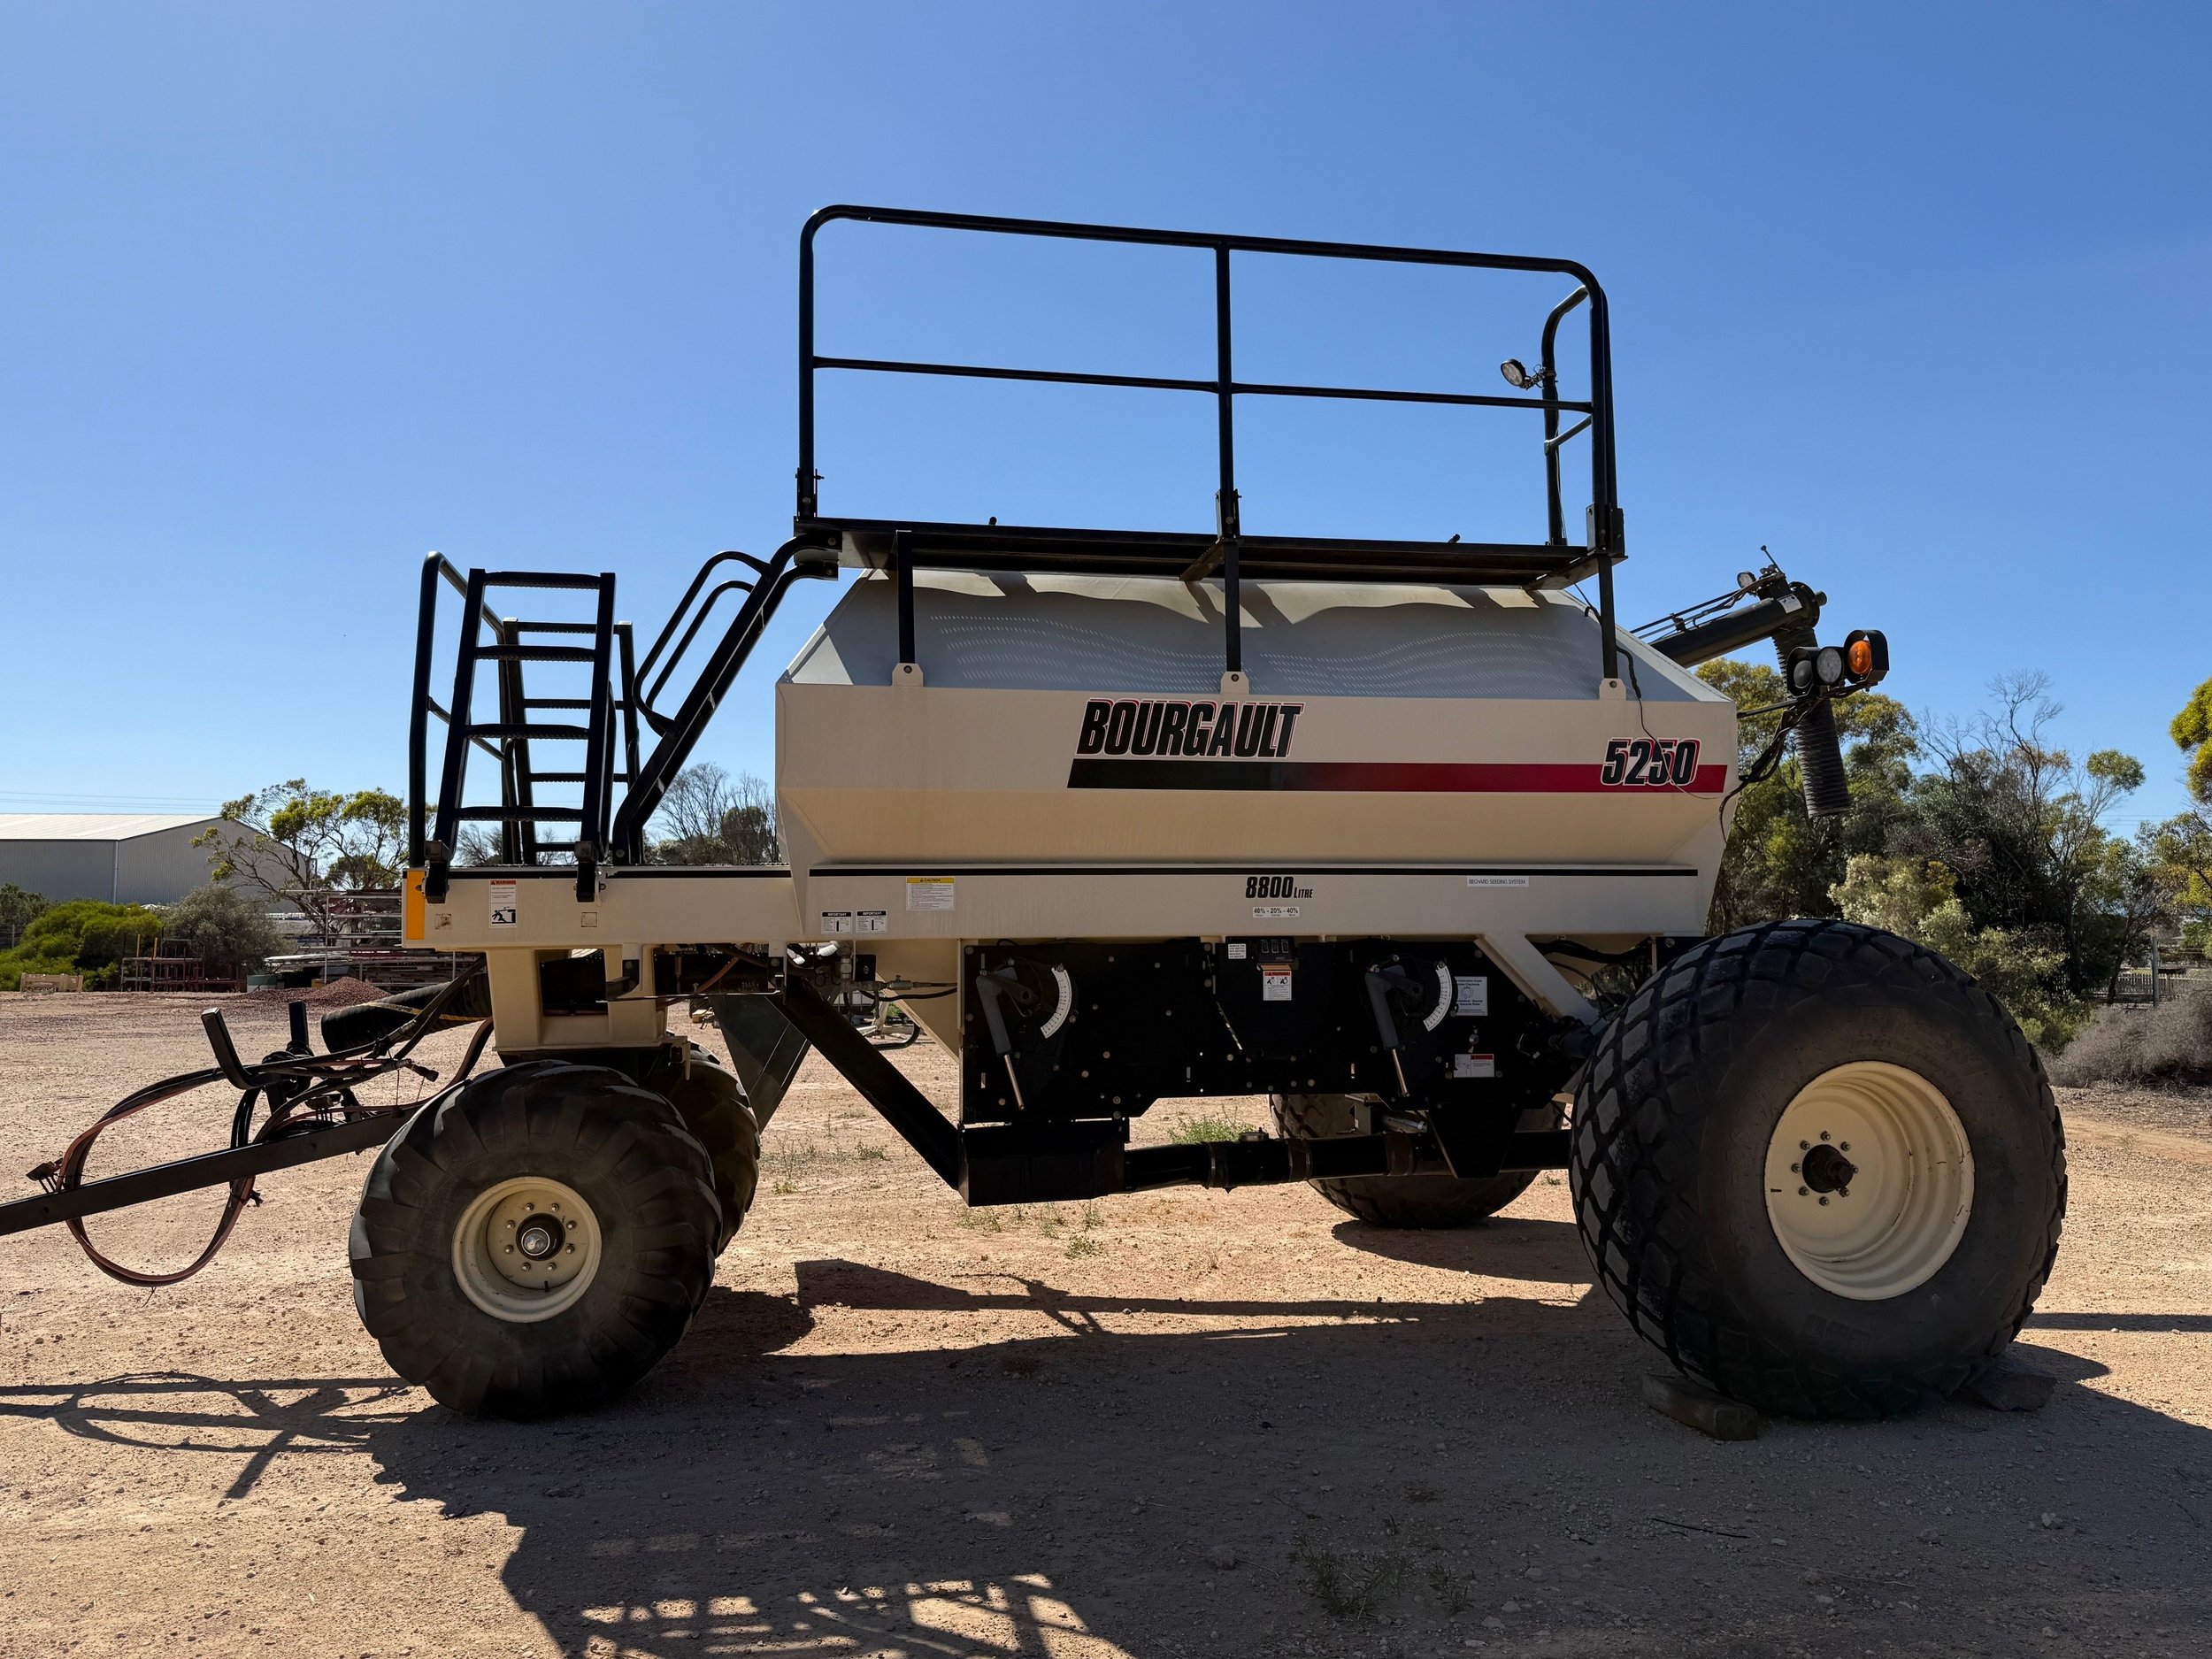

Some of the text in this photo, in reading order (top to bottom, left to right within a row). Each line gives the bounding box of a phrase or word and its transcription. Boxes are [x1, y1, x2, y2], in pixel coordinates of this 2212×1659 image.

[1076, 698, 1305, 758] BOURGAULT
[1601, 737, 1701, 786] 5250
[1246, 877, 1313, 898] 8800 LITRE
